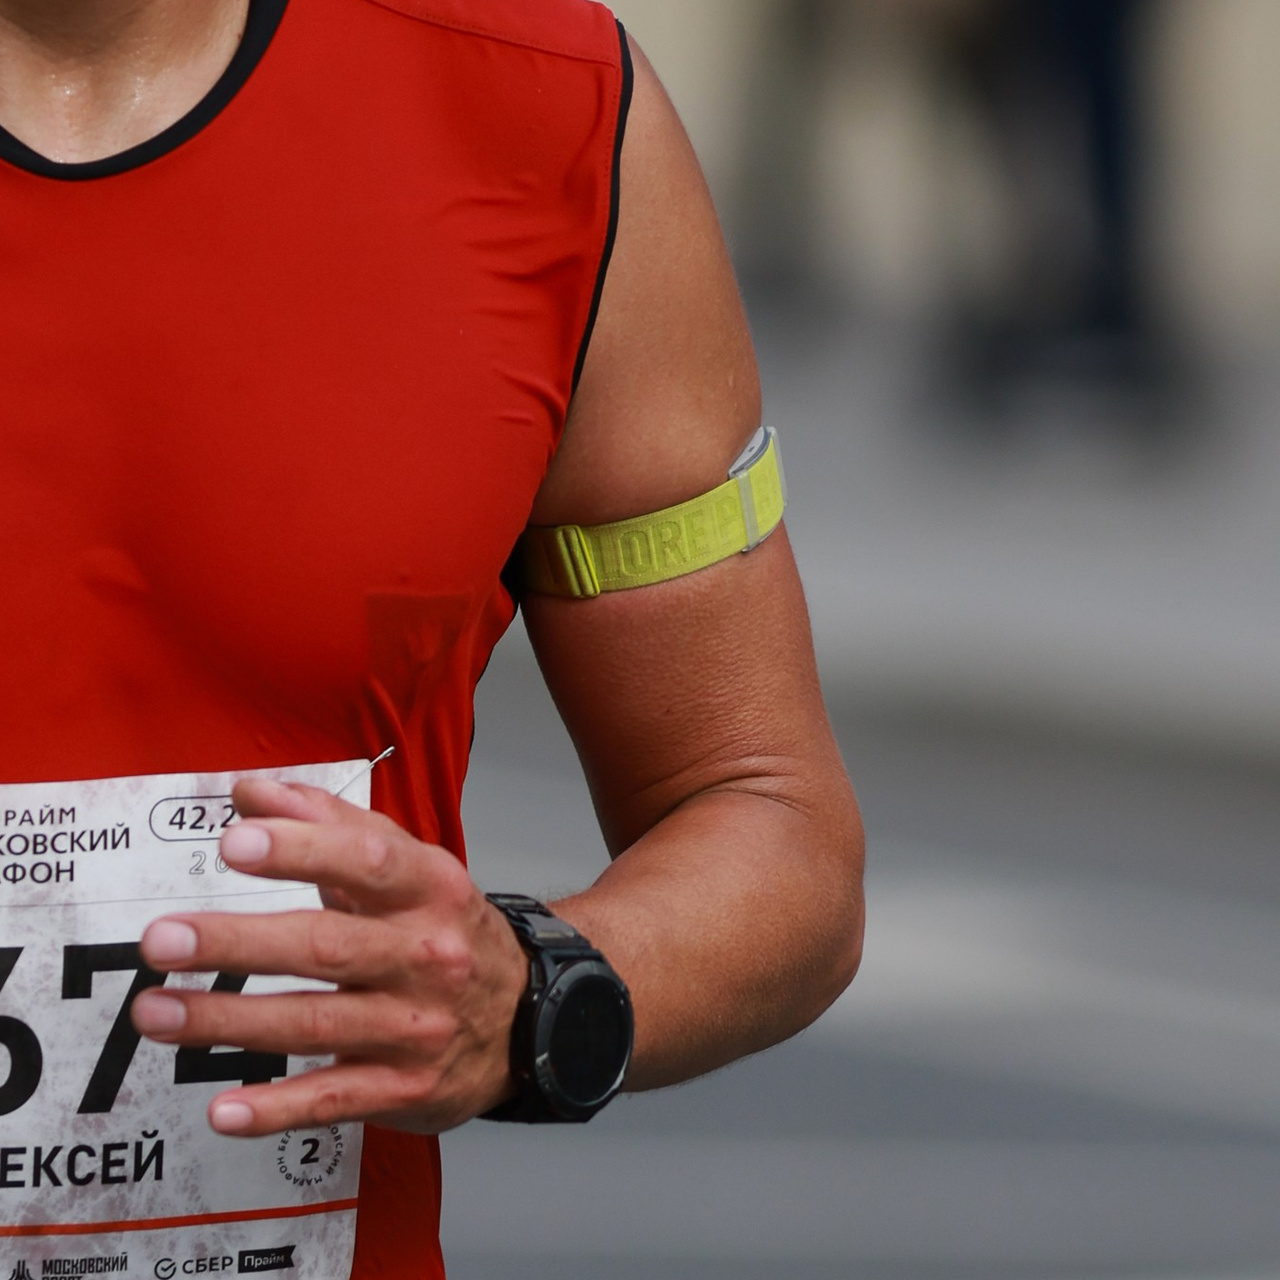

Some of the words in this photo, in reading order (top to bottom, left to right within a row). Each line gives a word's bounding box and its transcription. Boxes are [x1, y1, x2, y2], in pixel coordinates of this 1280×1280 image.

[300, 1137, 320, 1165] 2
[41, 1252, 128, 1276] МОСКОВСКИЙ
[182, 1256, 234, 1274] СБЕР
[244, 1253, 285, 1268] Прайм
